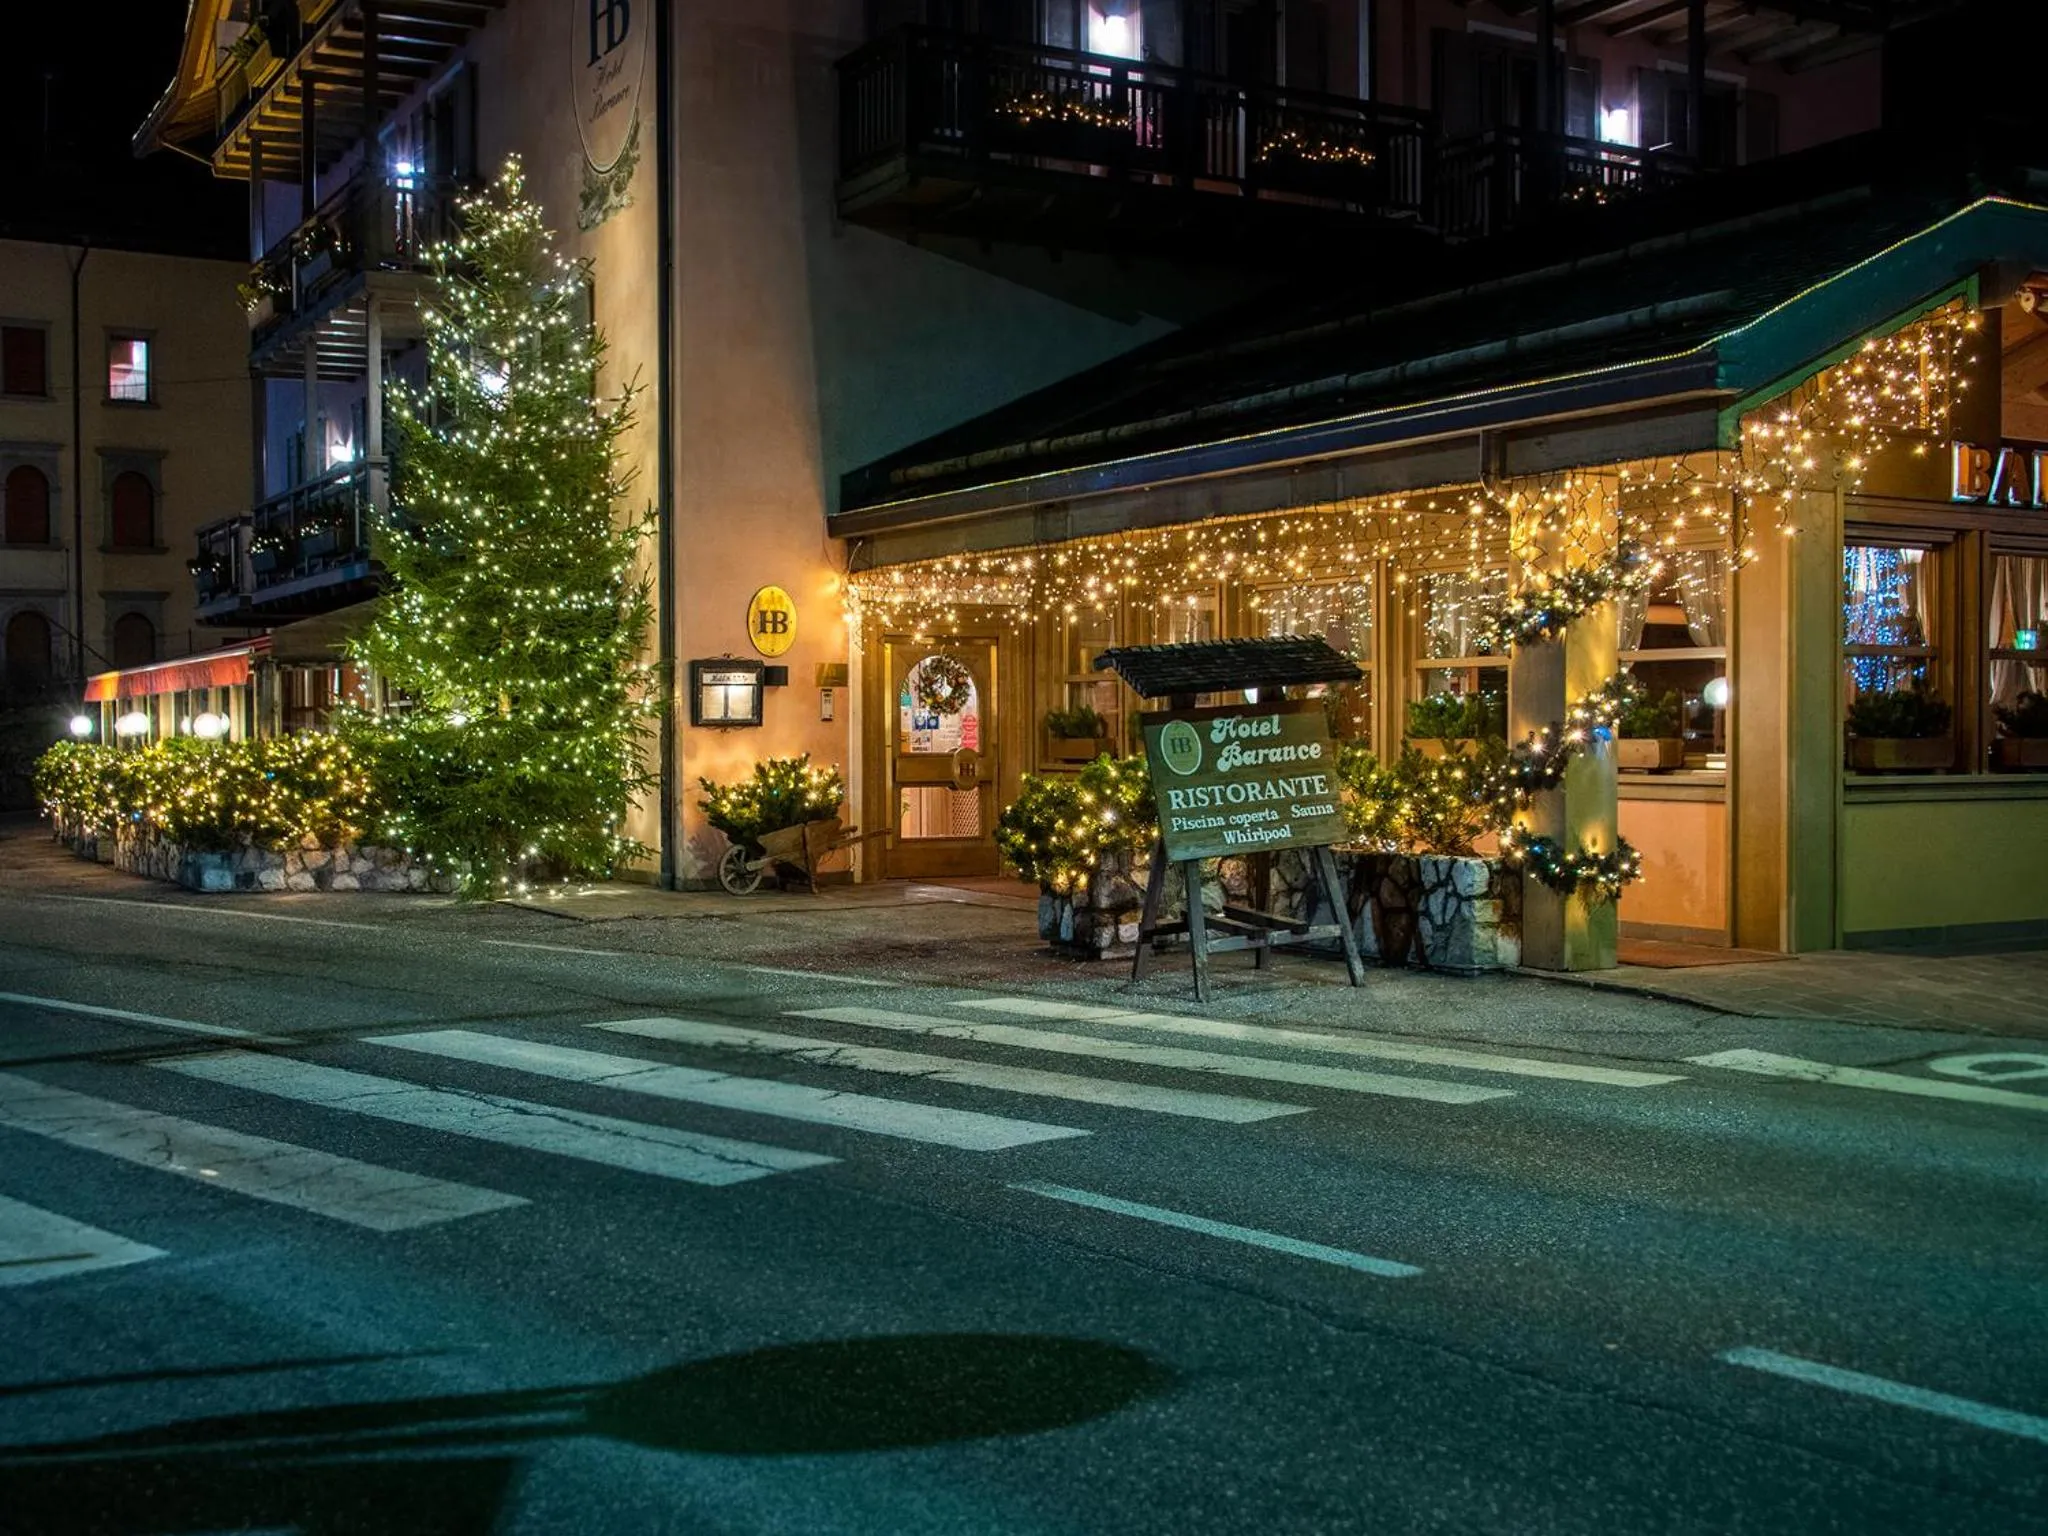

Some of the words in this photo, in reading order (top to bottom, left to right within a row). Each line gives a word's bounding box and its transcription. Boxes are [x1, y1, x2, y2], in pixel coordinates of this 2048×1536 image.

[757, 610, 788, 634] HB
[1210, 714, 1282, 744] Hotel
[1217, 741, 1322, 772] Barance
[1167, 775, 1330, 810] RISTORANTE
[1171, 815, 1226, 832] Piscina
[1229, 808, 1279, 827] coperta
[1290, 802, 1335, 819] Sauna
[1223, 824, 1293, 845] Whirlpool
